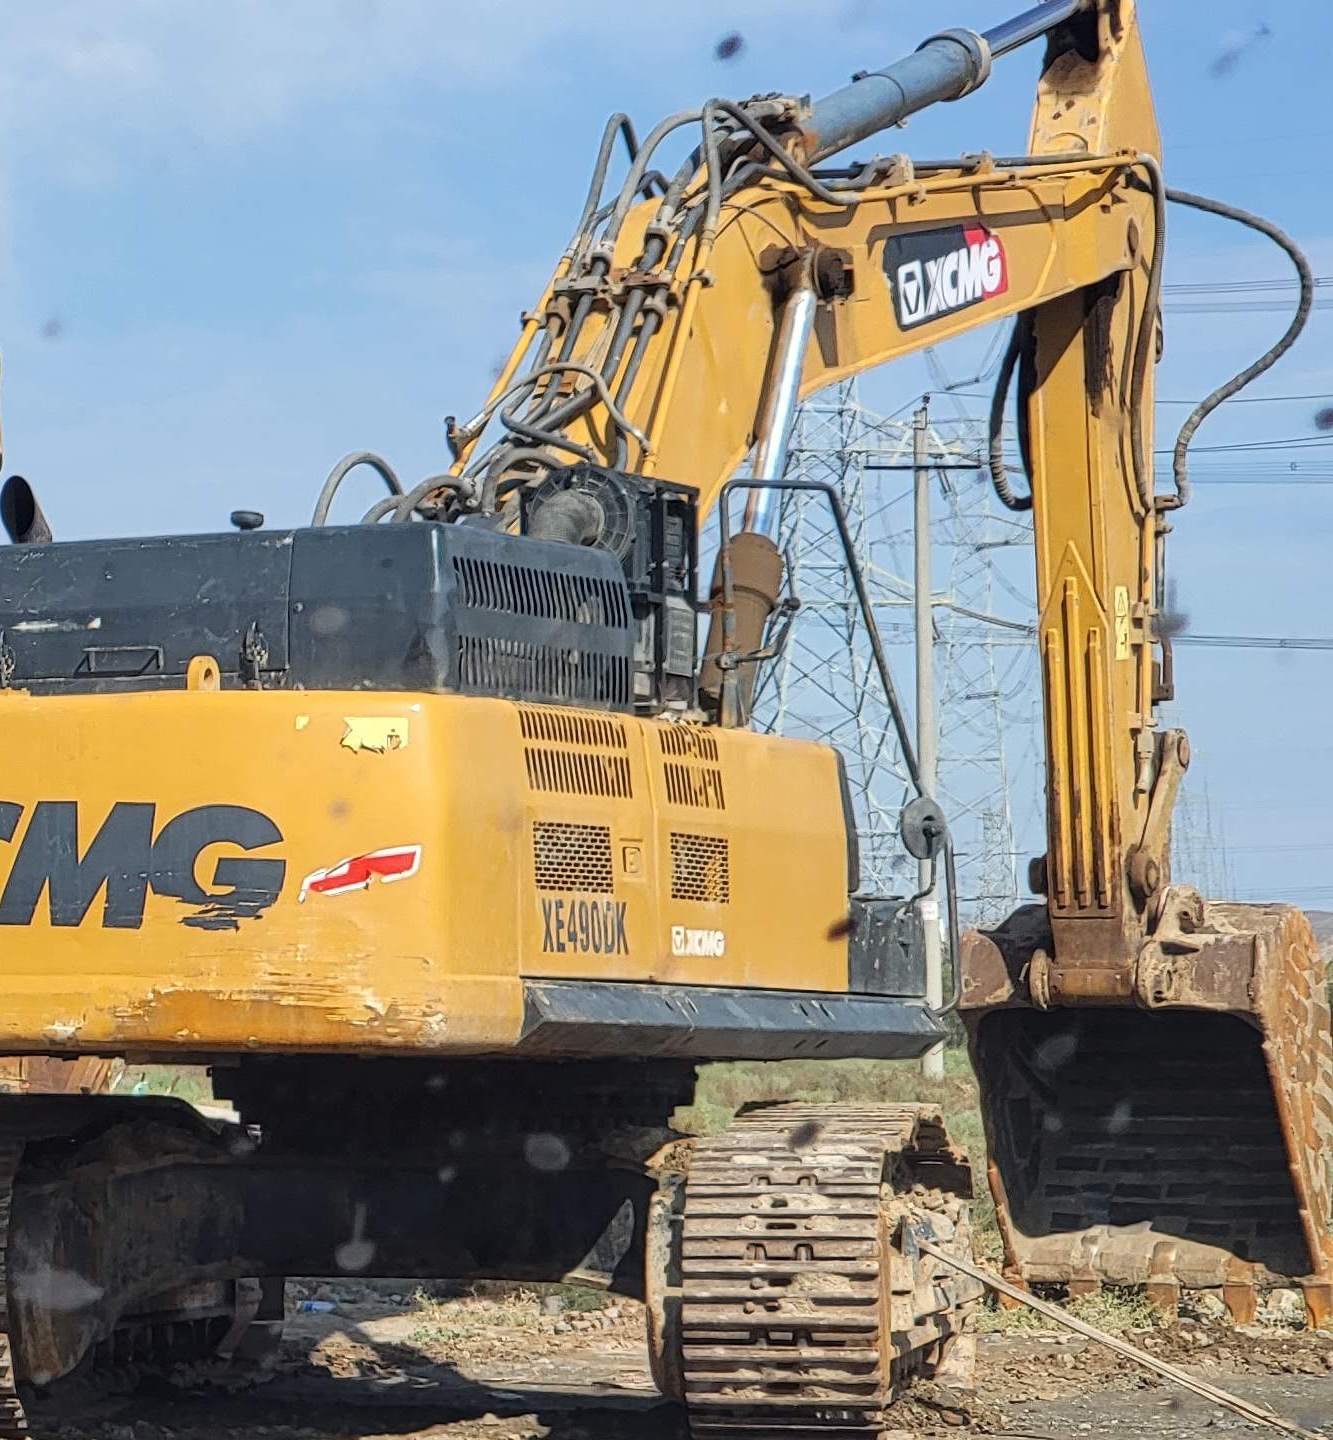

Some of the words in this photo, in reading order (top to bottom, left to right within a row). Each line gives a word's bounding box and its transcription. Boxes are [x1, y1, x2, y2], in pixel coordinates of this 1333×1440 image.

[924, 238, 1002, 314] XCMG
[542, 898, 630, 955] XE490DK
[685, 928, 726, 957] XCMG
